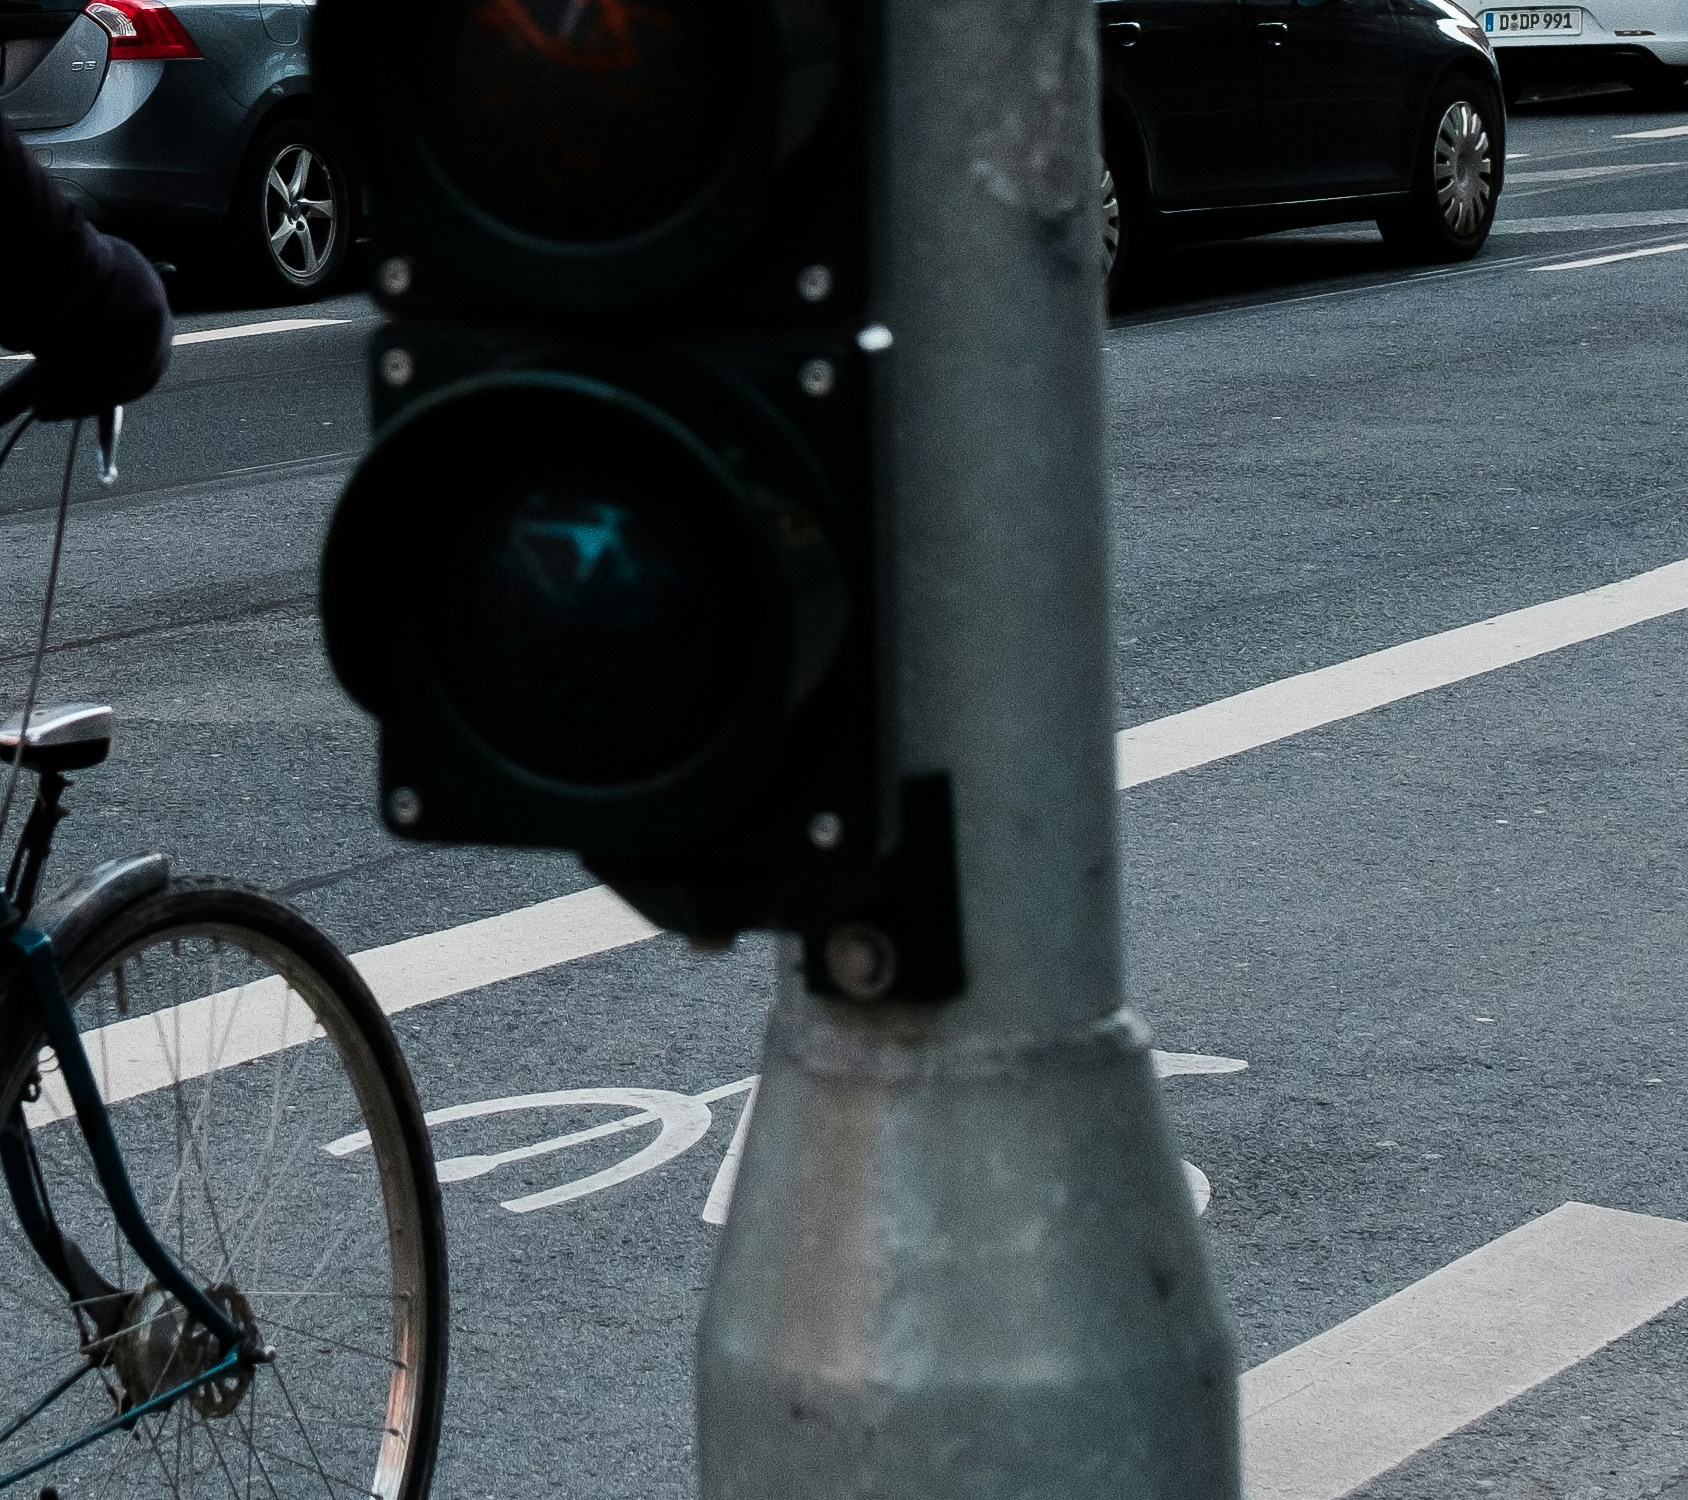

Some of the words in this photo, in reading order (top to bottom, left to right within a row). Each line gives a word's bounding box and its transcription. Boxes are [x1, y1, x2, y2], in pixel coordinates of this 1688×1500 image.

[1499, 14, 1509, 31] D
[1519, 13, 1540, 31] DP
[1543, 12, 1572, 29] 991
